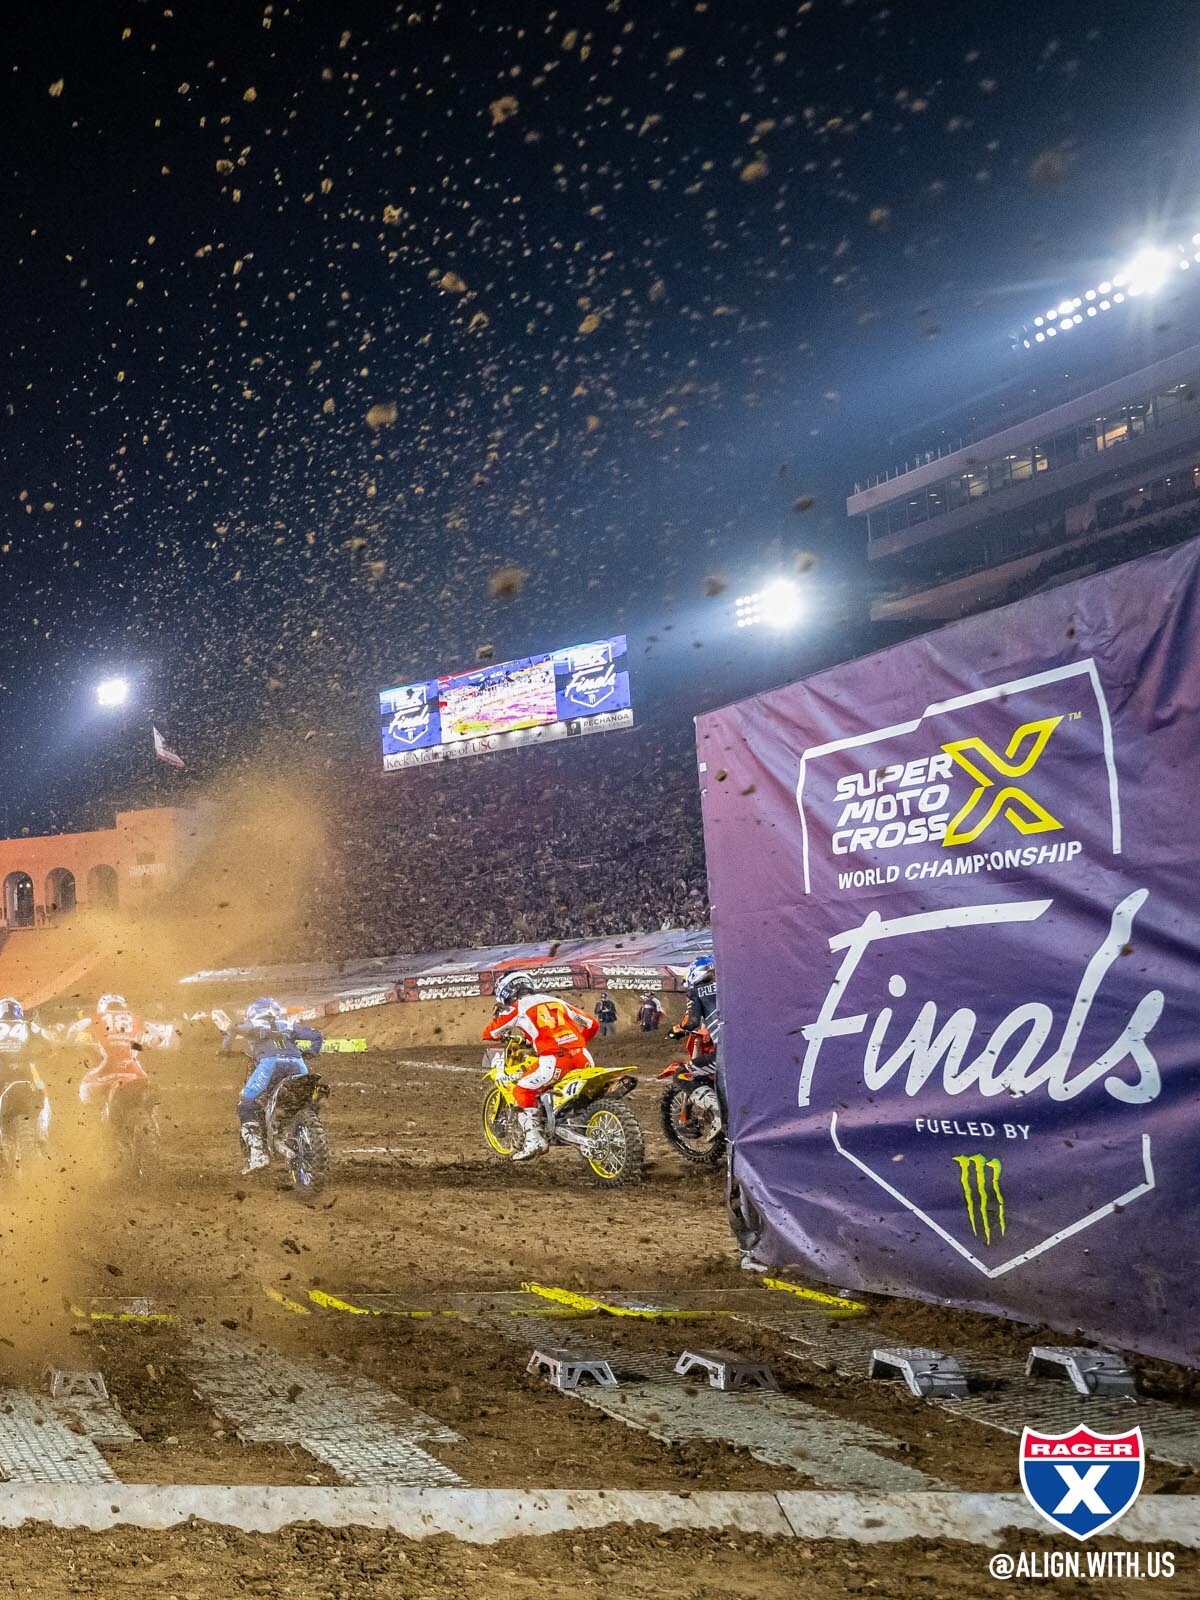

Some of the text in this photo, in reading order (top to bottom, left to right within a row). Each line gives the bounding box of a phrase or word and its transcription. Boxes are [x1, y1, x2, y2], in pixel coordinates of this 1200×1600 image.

[583, 713, 630, 728] PECHANGA
[386, 756, 410, 769] Keck
[459, 744, 469, 756] of
[472, 738, 497, 752] USC
[833, 753, 954, 802] SUPER
[837, 784, 950, 827] MOTO
[832, 813, 951, 855] CROSS
[838, 865, 900, 890] WORLD
[798, 887, 1165, 1107] Finals
[537, 1002, 566, 1029] 47
[566, 1081, 579, 1097] 47
[915, 1118, 1031, 1140] FUELED BY
[928, 1363, 939, 1371] 2
